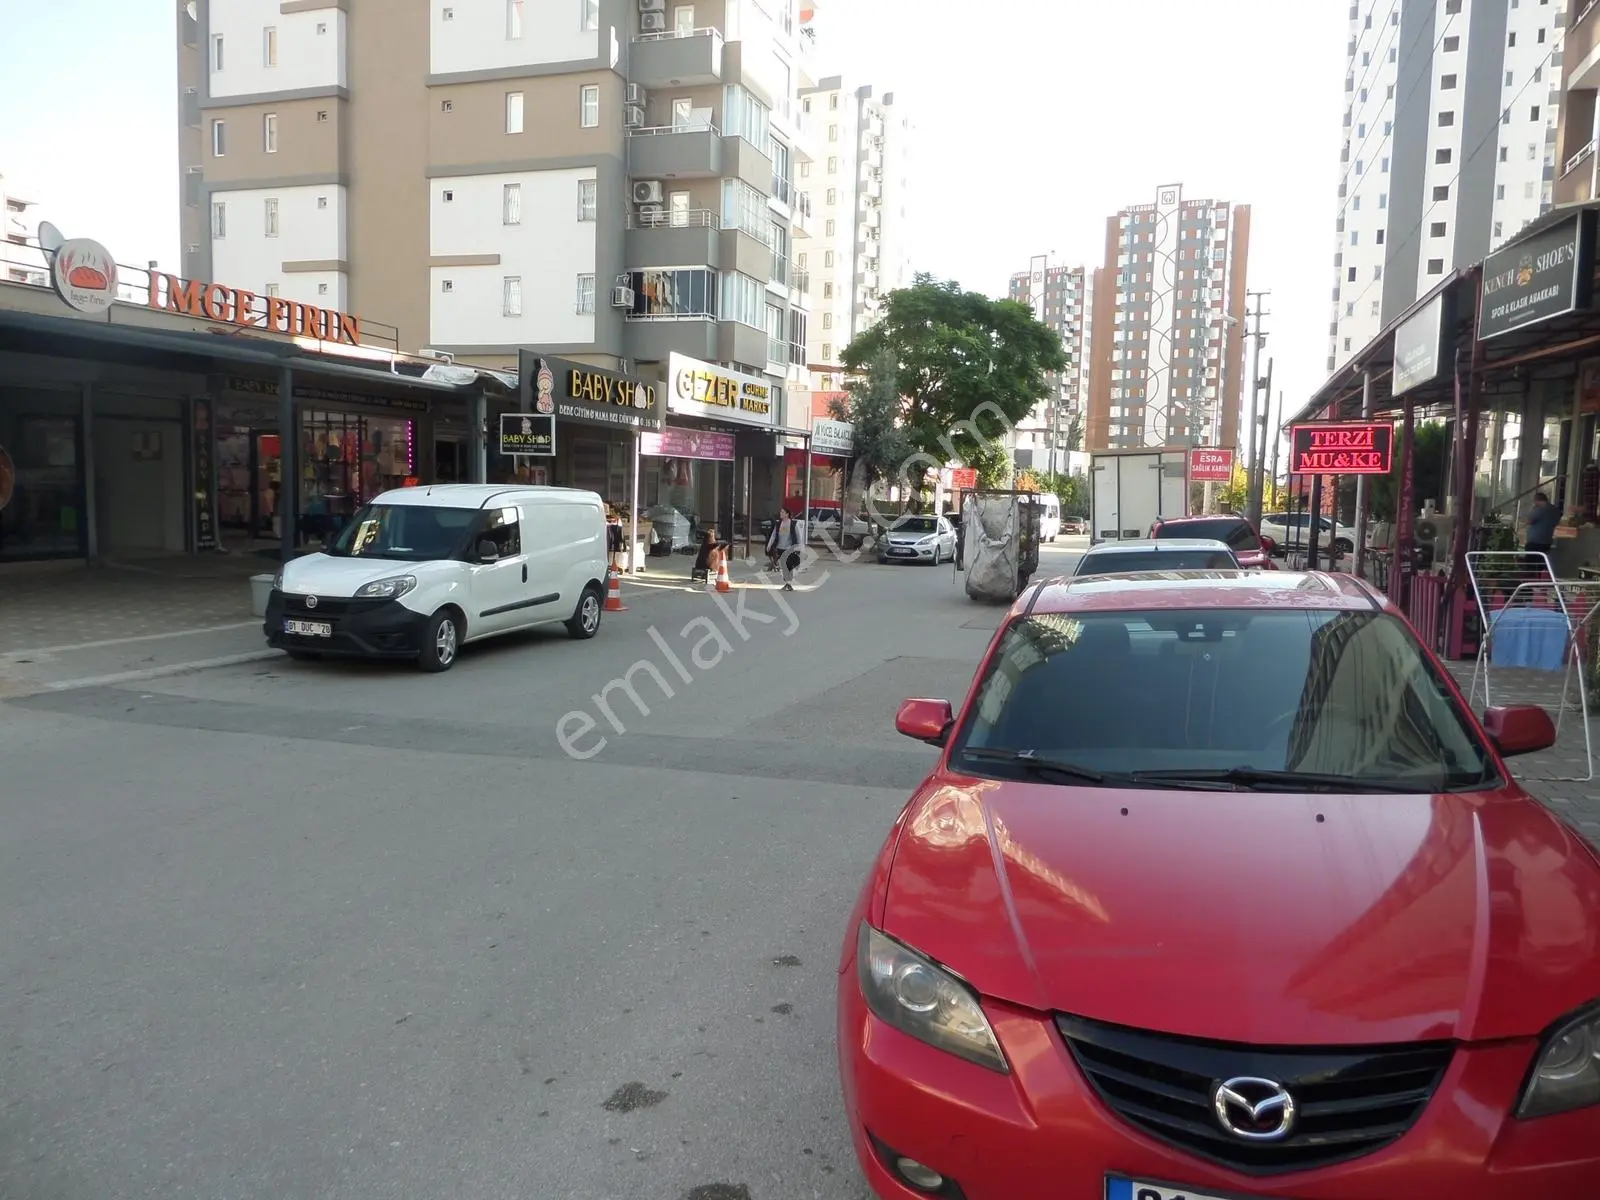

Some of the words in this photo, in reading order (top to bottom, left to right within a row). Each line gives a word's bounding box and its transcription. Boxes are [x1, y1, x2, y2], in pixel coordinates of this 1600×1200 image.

[1536, 241, 1575, 273] SHOE'S
[266, 295, 361, 346] FIRIN
[571, 368, 613, 402] BABY
[676, 367, 739, 409] GEZER
[741, 398, 770, 415] MARKET
[503, 434, 525, 443] BABY
[1311, 427, 1374, 446] TERZİ
[1200, 455, 1223, 463] ESRA
[1300, 452, 1380, 467] MU&KE
